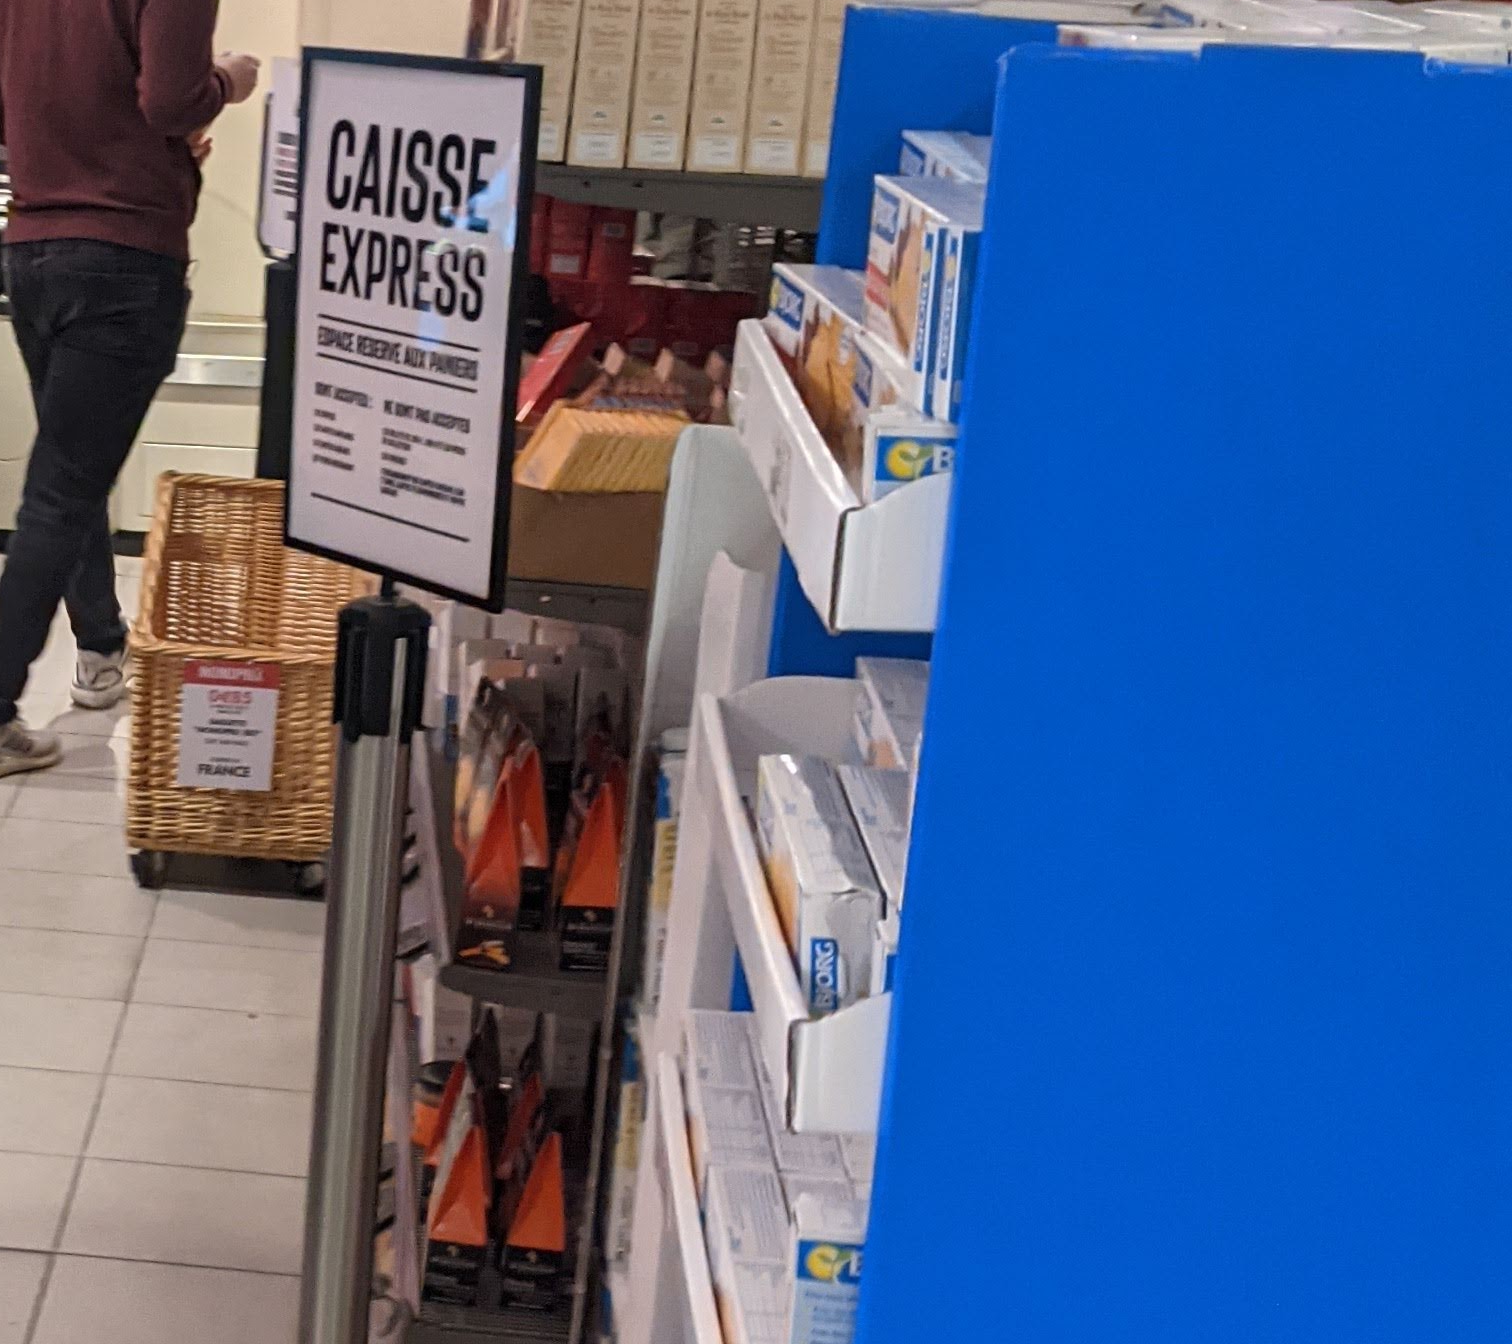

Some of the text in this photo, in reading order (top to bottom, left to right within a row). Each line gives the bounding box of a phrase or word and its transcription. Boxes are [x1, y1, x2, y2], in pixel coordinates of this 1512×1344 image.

[326, 119, 497, 234] CAISSE
[318, 221, 487, 323] EXPRESS
[403, 345, 426, 369] AUX
[198, 763, 251, 778] FRANCE
